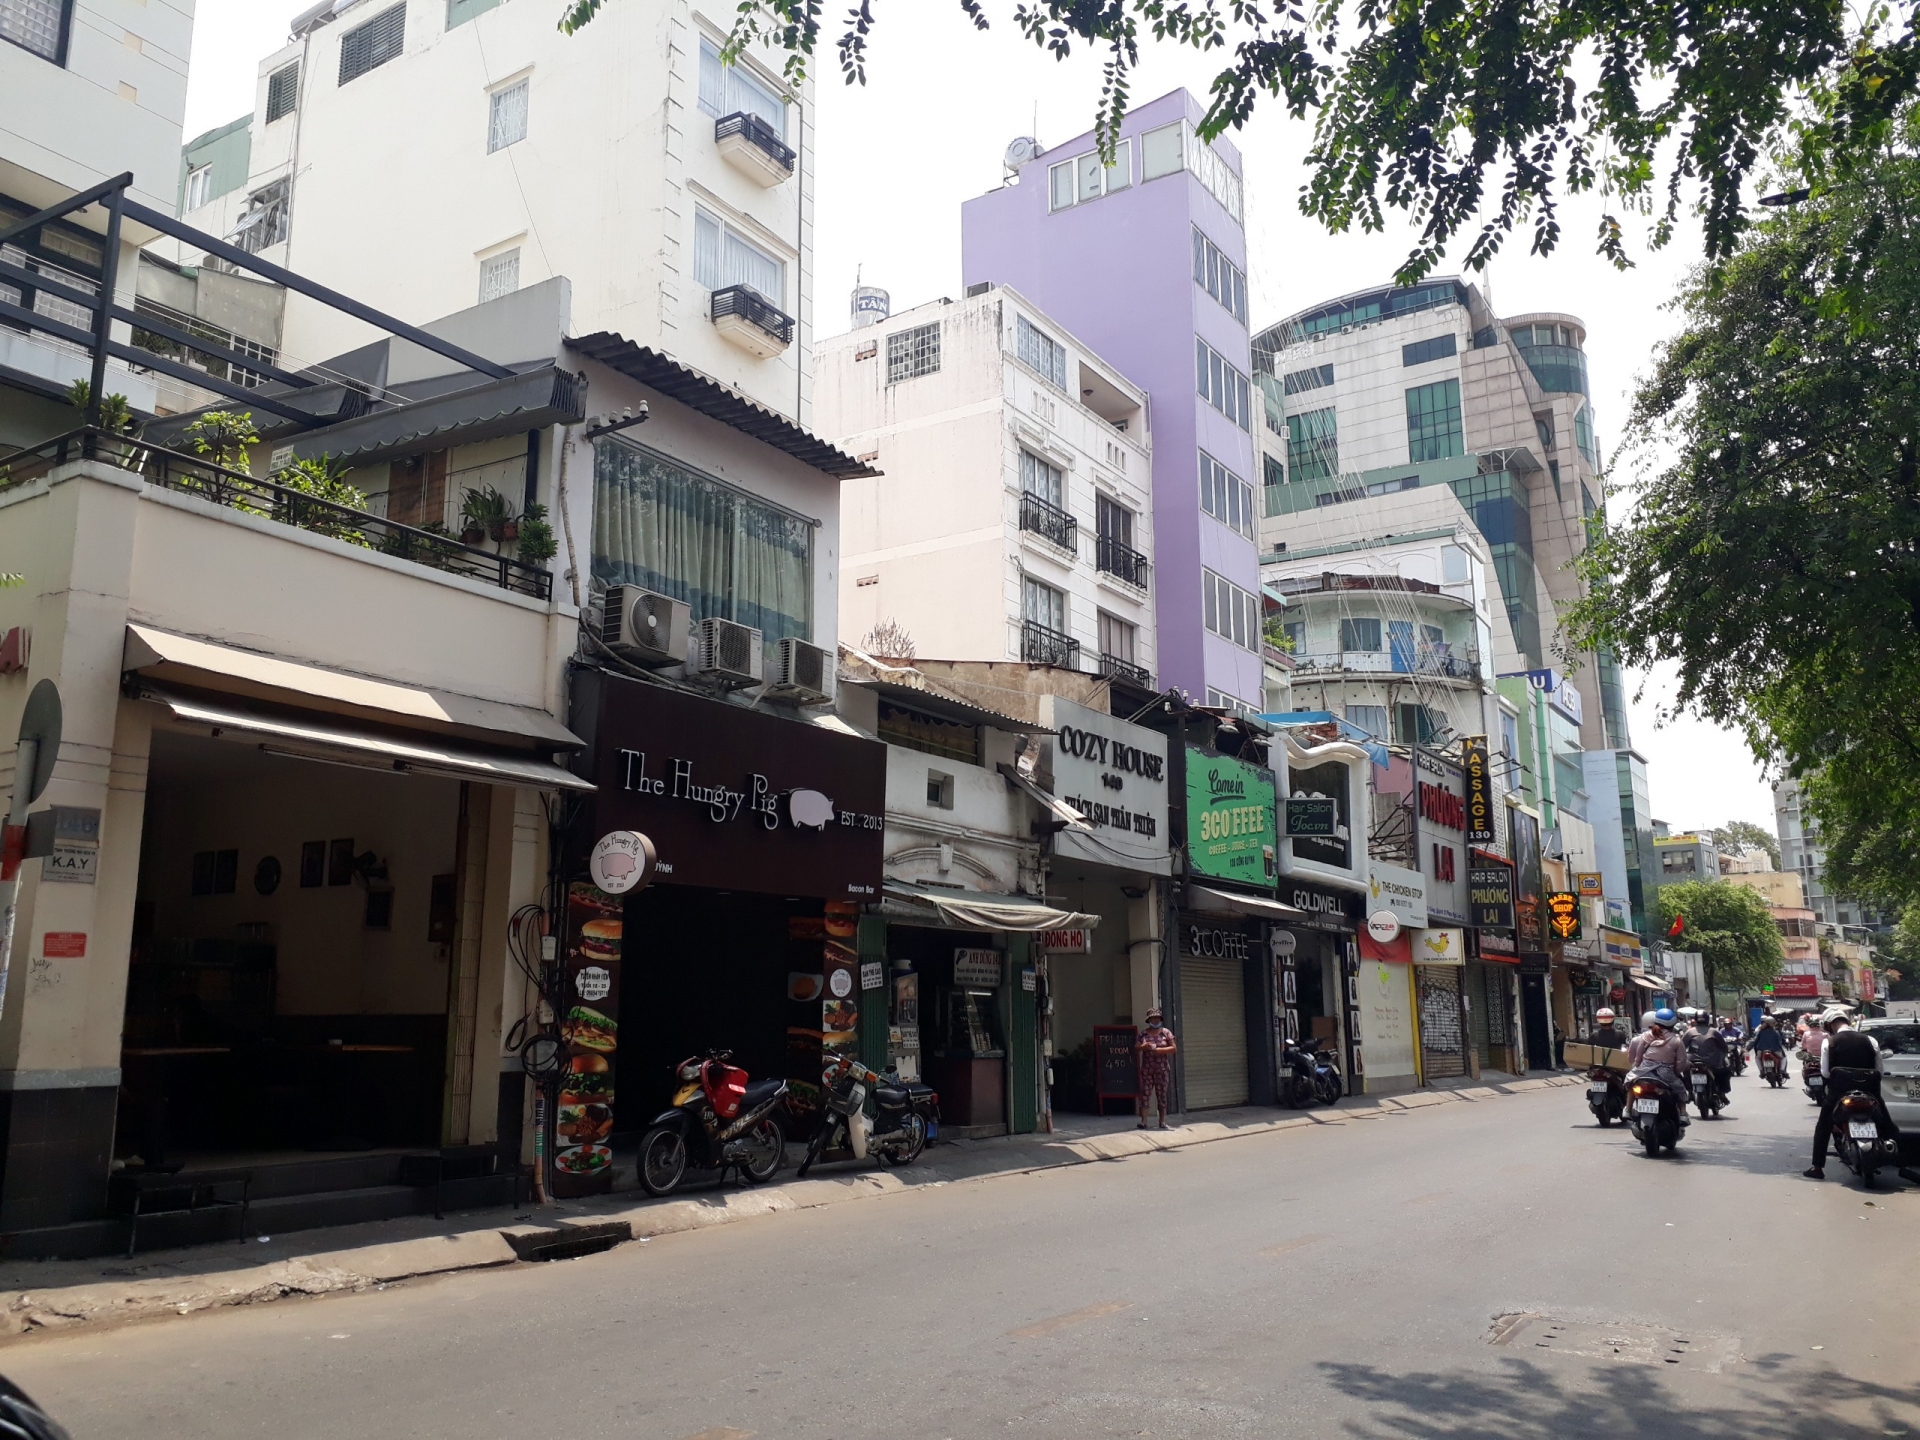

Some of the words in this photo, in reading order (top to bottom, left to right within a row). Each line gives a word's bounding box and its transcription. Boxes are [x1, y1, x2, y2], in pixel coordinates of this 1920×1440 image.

[1060, 725, 1109, 764] COZY
[1112, 740, 1164, 781] HOUSE
[620, 749, 665, 796] The
[672, 758, 746, 823] Hungry
[750, 774, 779, 830] Pig
[1467, 738, 1485, 830] MASSAGE
[1288, 804, 1306, 813] Hair
[1307, 803, 1332, 813] Salon
[863, 813, 883, 831] 2013
[1134, 811, 1156, 840] THIỆN
[1469, 831, 1491, 839] 130
[53, 856, 89, 870] K.A.Y
[1434, 843, 1455, 883] LAI
[1471, 872, 1485, 883] HAIR
[1487, 871, 1508, 883] SALON
[848, 884, 864, 893] Bacon
[865, 885, 875, 894] Bar
[1382, 880, 1391, 893] THE
[1391, 883, 1412, 897] CHICKEN
[1412, 887, 1423, 899] STOP
[1293, 889, 1345, 916] GOLDWELL
[1553, 904, 1574, 913] SHOP
[1483, 908, 1499, 924] LAI
[1109, 1047, 1129, 1055] ROOM
